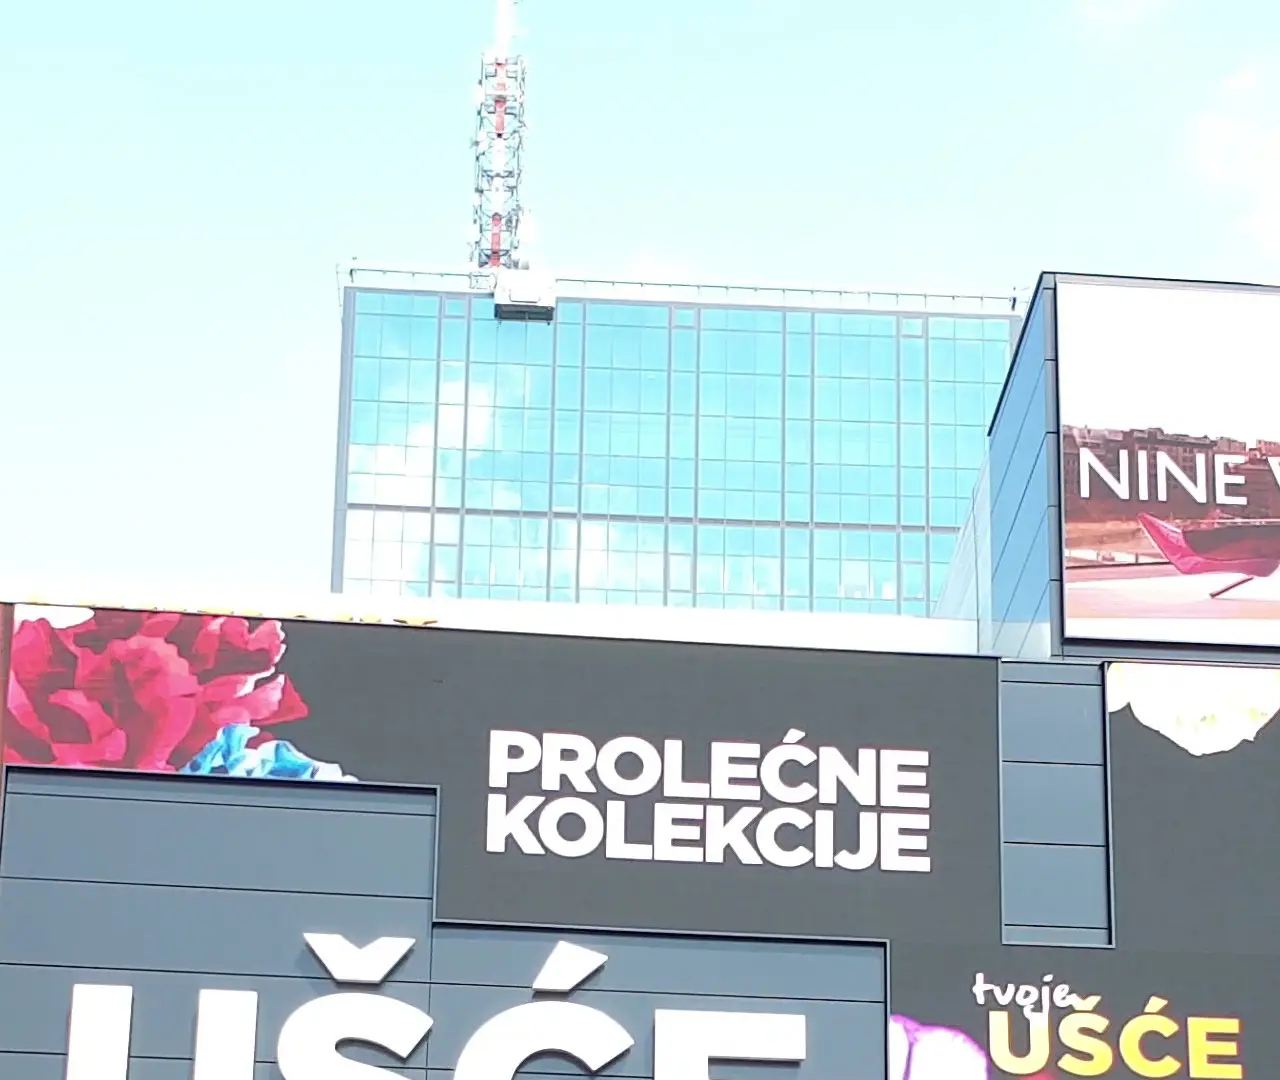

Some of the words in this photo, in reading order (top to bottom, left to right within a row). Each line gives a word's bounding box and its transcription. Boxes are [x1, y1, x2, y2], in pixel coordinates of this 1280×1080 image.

[1080, 447, 1248, 505] NINE
[488, 729, 931, 809] PROLEĆNE
[487, 794, 931, 872] KOLEKCIJE
[972, 972, 1076, 1019] tvoje
[988, 994, 1244, 1080] UŠĆE
